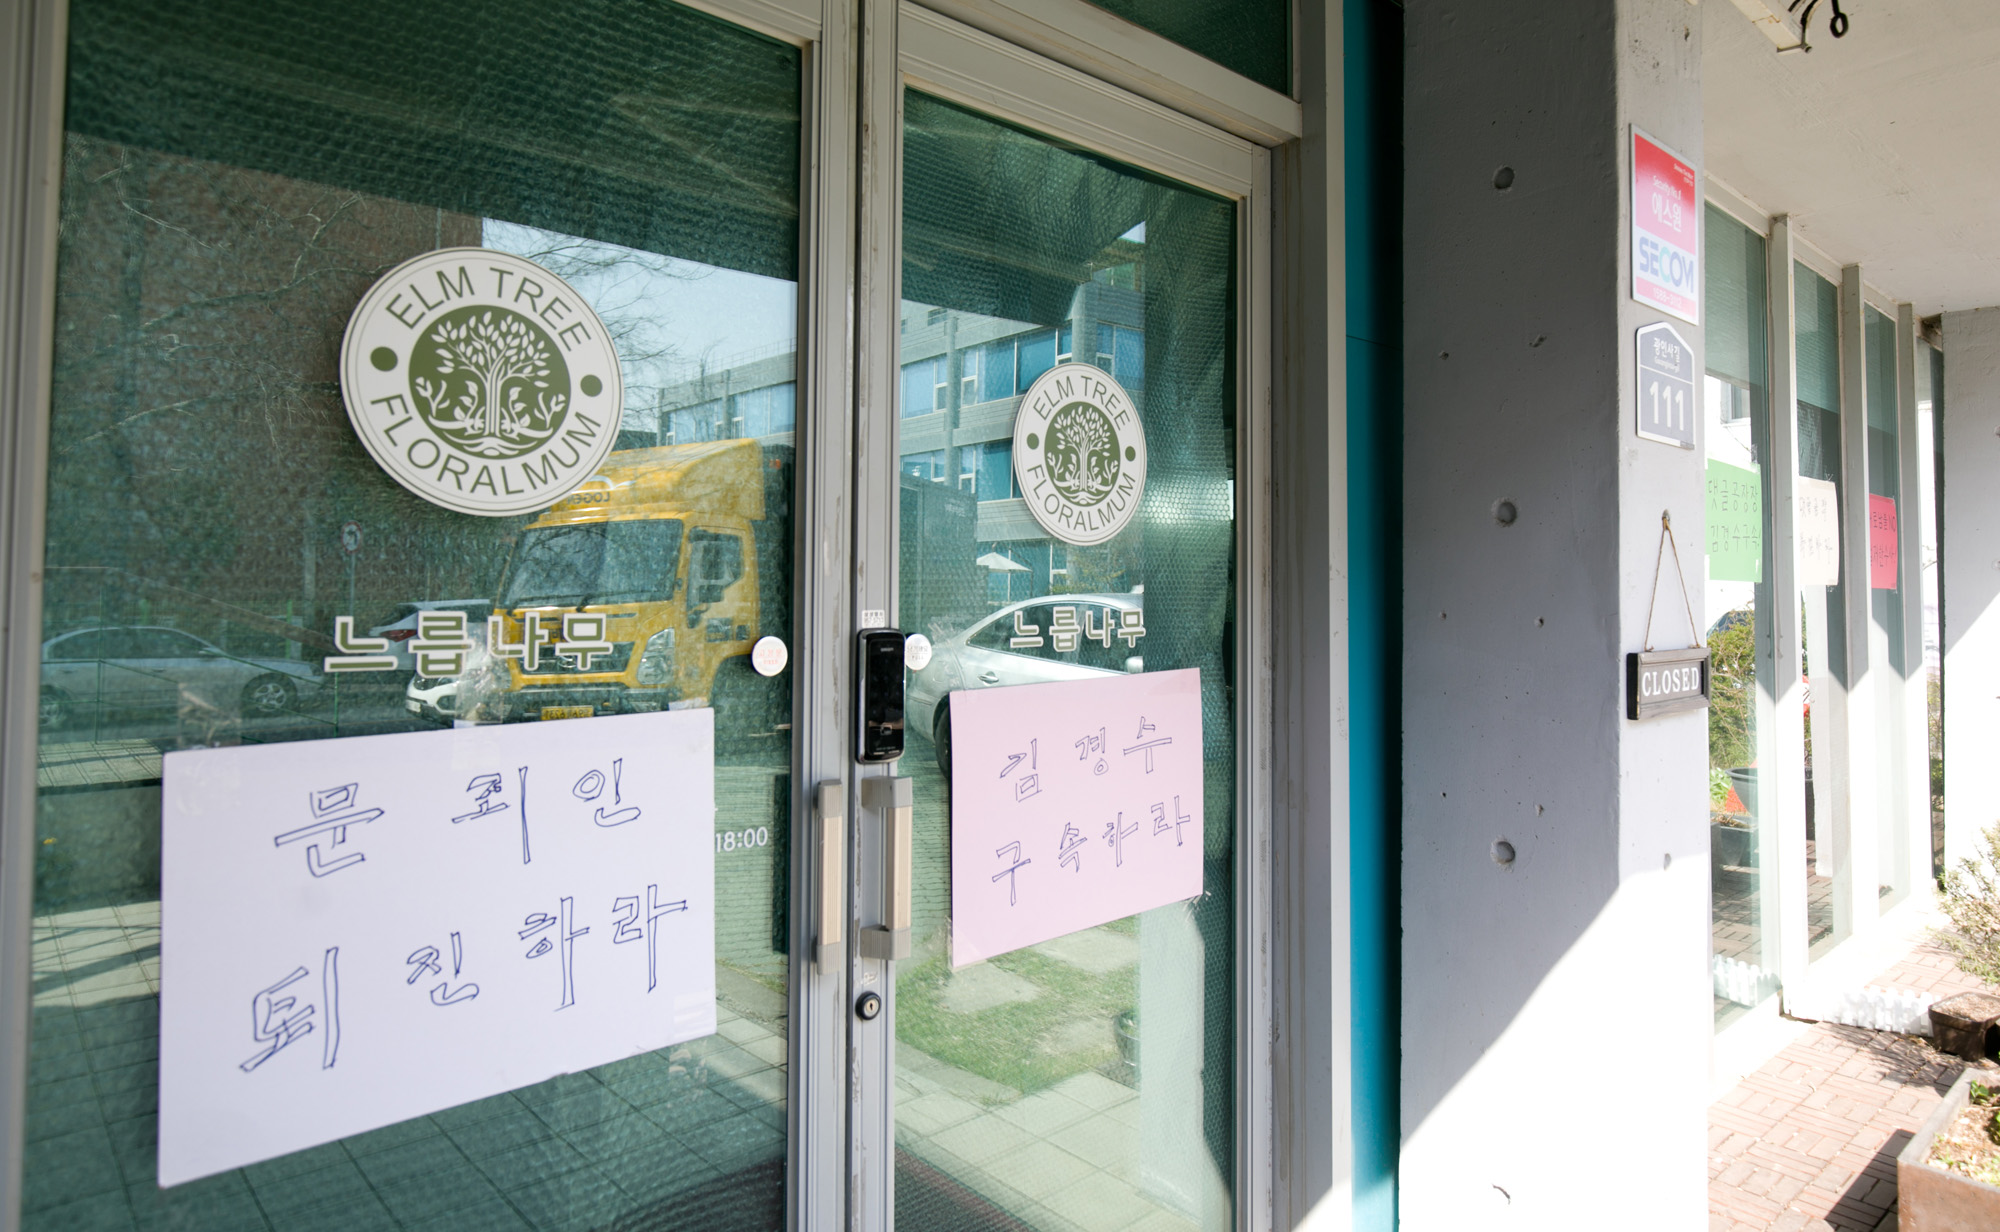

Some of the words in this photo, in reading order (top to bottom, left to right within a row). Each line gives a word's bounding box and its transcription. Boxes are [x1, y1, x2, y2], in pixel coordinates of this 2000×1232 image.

[1652, 192, 1682, 233] 에스원
[1639, 236, 1694, 294] SECOM
[385, 266, 475, 329] ELM
[489, 267, 592, 352] TREE
[1033, 375, 1075, 421] ELM
[1080, 375, 1130, 431] TREE
[1649, 381, 1684, 431] 111
[370, 394, 602, 496] FLORALMUM
[1027, 464, 1136, 531] FLORALMUM
[324, 610, 613, 679] 느릅나무
[1010, 606, 1146, 652] 느릅나무
[1641, 667, 1700, 697] CLOSED
[715, 826, 768, 853] 18:00
[991, 795, 1191, 907] 구속하라
[238, 884, 688, 1074] 퇴진하라
